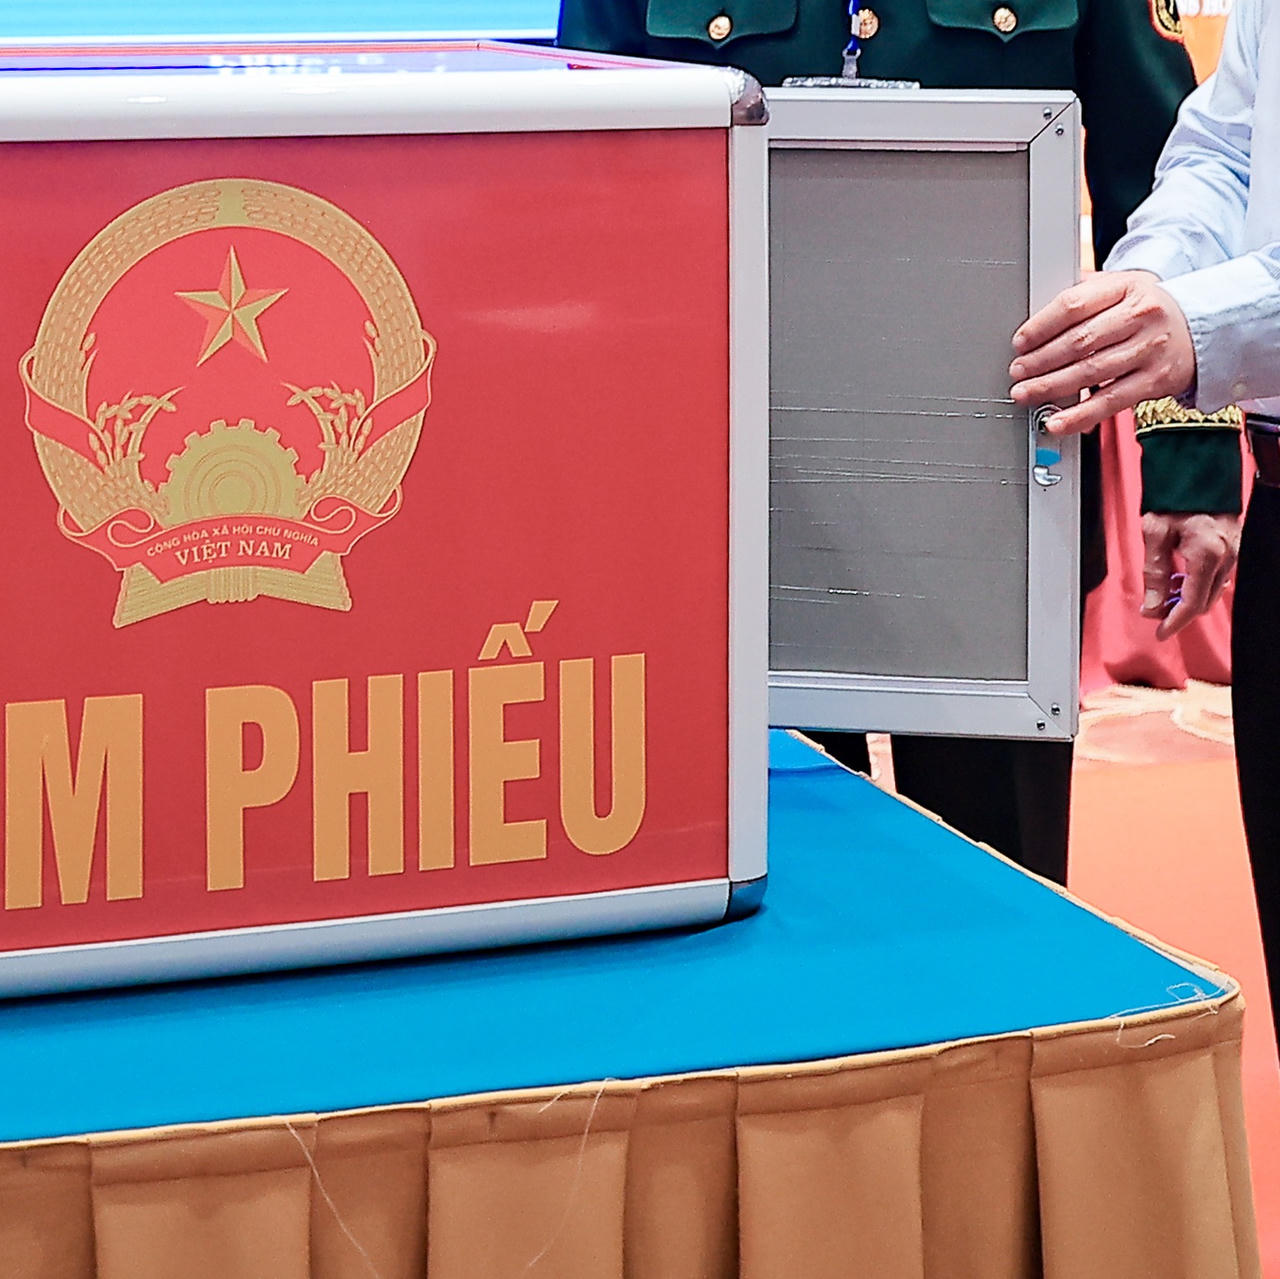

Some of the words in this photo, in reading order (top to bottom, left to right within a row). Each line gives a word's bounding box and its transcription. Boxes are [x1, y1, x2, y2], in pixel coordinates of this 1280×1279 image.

[175, 539, 231, 566] VIỆT
[237, 539, 292, 560] NAM
[204, 600, 647, 892] PHIẾU
